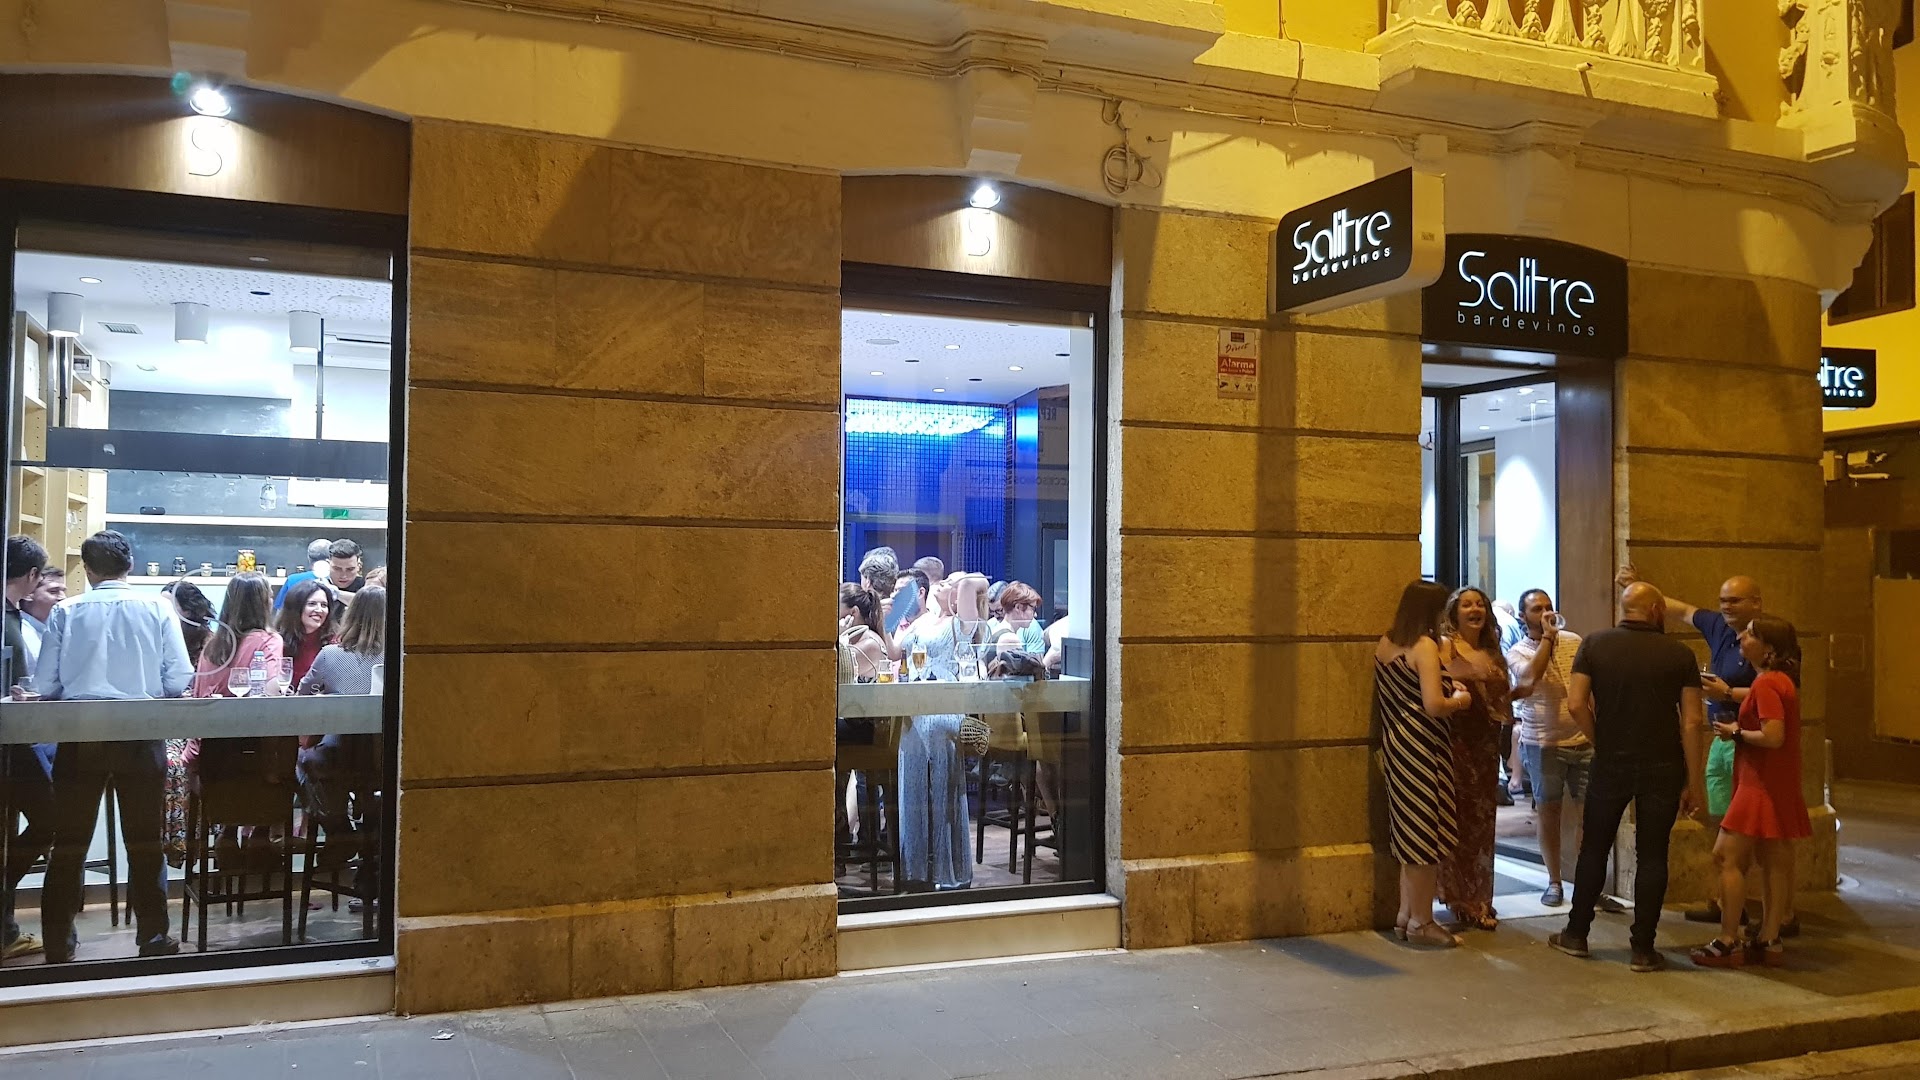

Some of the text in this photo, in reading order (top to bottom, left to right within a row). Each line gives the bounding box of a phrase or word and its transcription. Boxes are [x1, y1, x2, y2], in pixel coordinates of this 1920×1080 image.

[188, 123, 226, 177] S
[1291, 206, 1392, 271] Salitre
[1291, 246, 1392, 285] bardevinos
[1457, 250, 1596, 319] Salitre
[1456, 311, 1596, 337] bardevinos
[1220, 357, 1255, 369] Alarma
[1818, 357, 1864, 388] itre
[1824, 388, 1863, 397] vinos
